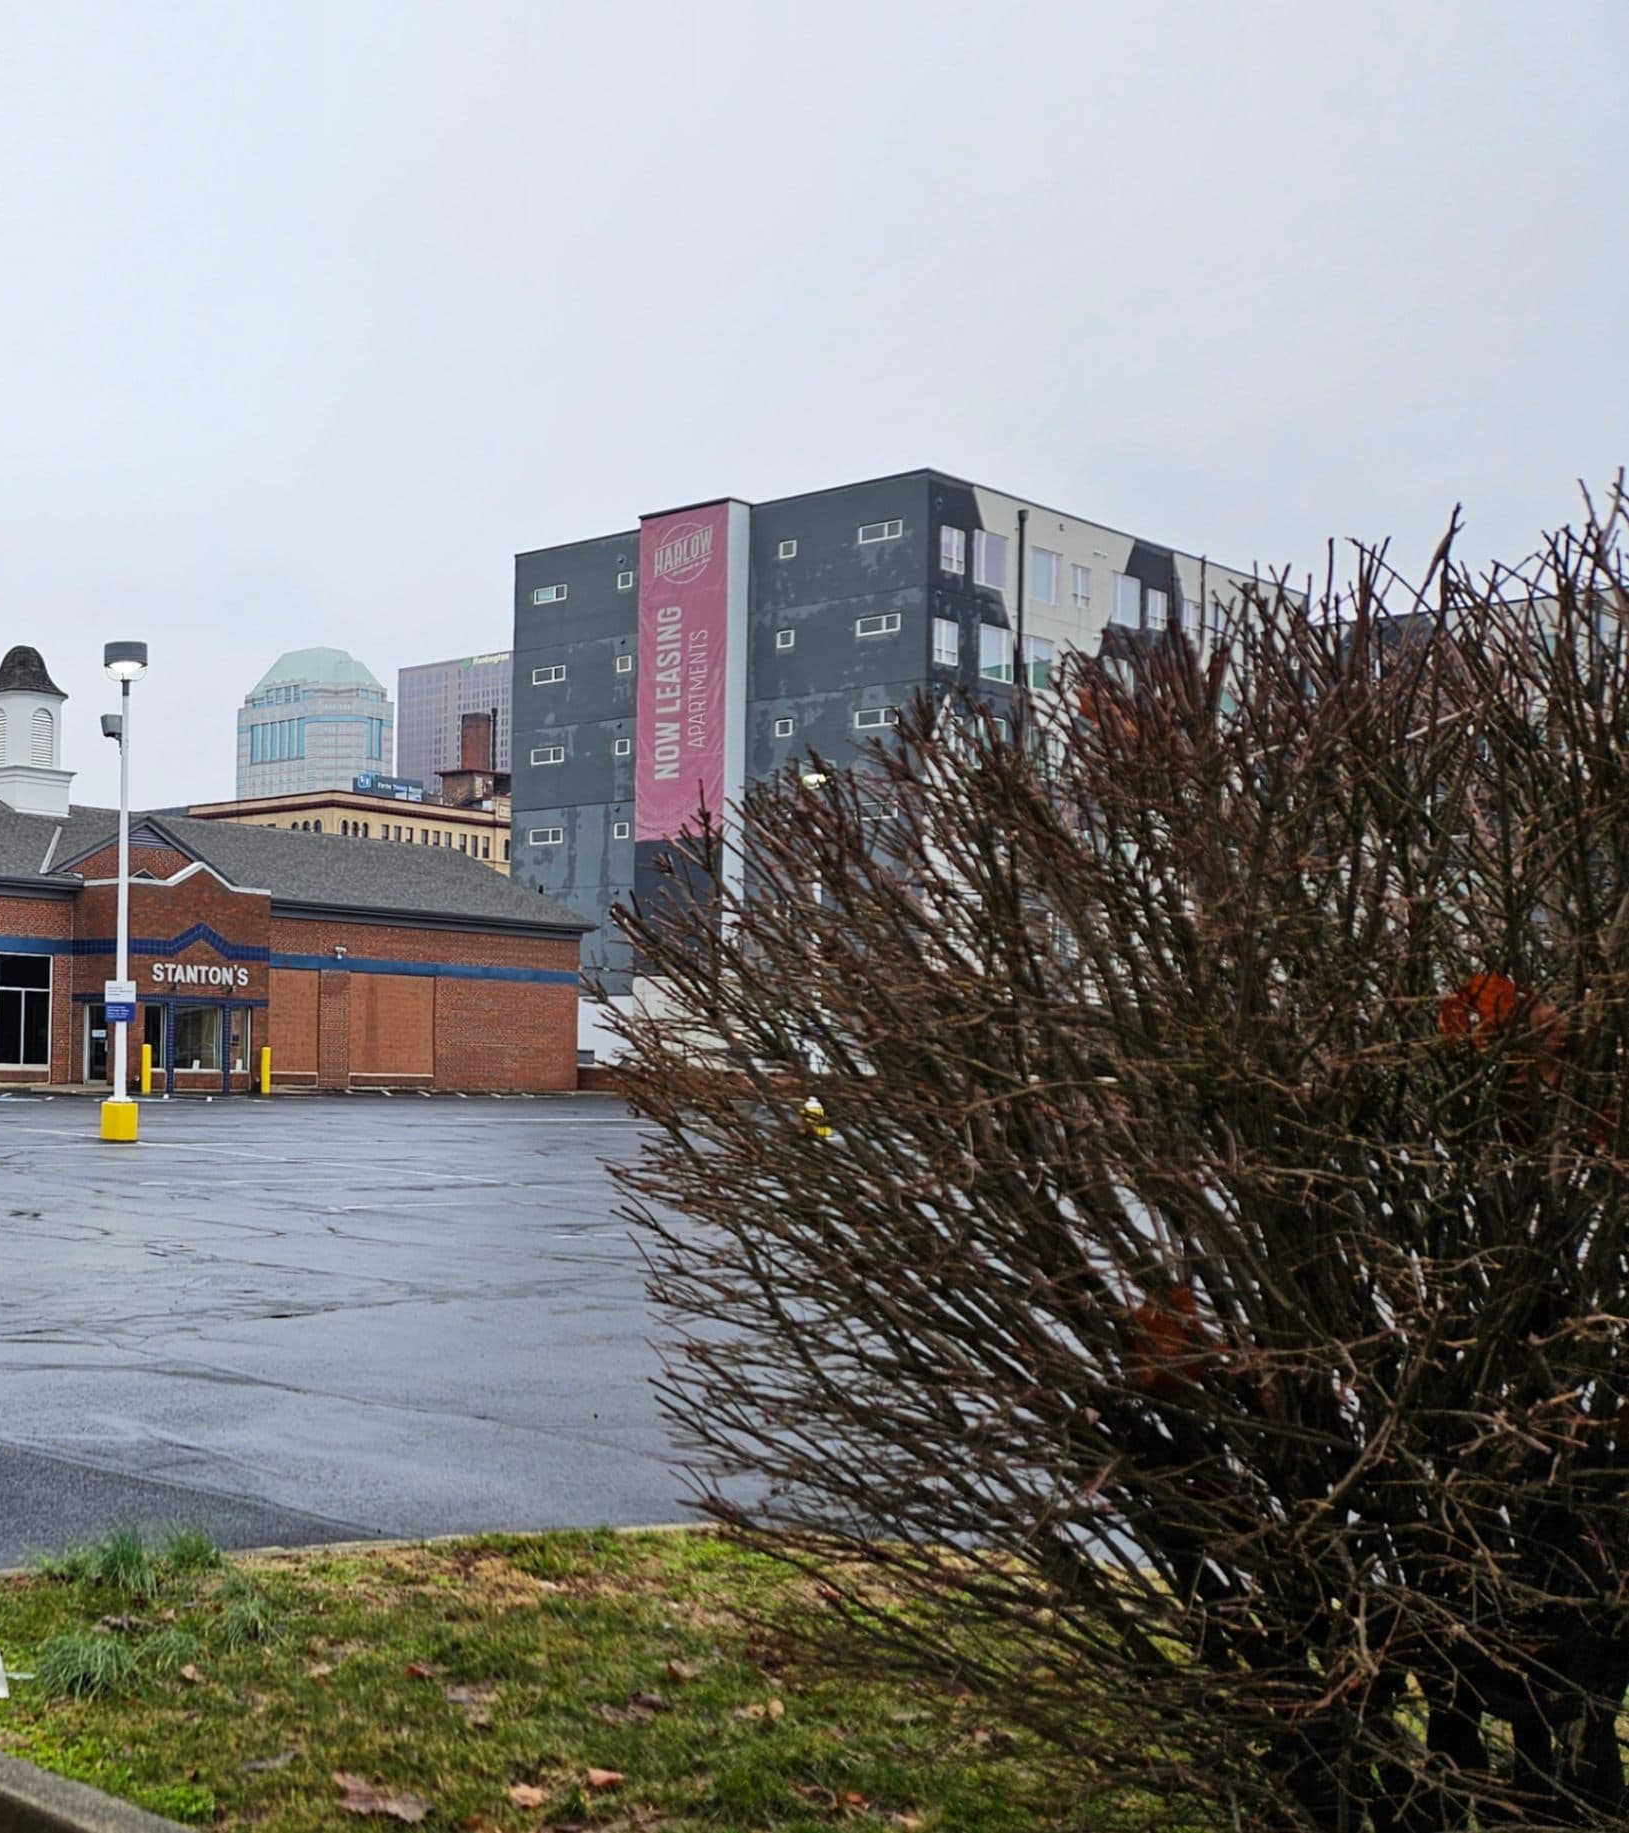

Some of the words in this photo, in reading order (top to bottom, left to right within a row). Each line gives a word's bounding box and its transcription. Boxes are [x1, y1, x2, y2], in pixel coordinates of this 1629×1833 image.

[654, 528, 713, 577] HARLOW
[656, 606, 682, 713] LEASING
[688, 629, 708, 748] APARTMENTS
[655, 723, 681, 780] NOW
[152, 963, 249, 986] STANTON'S
